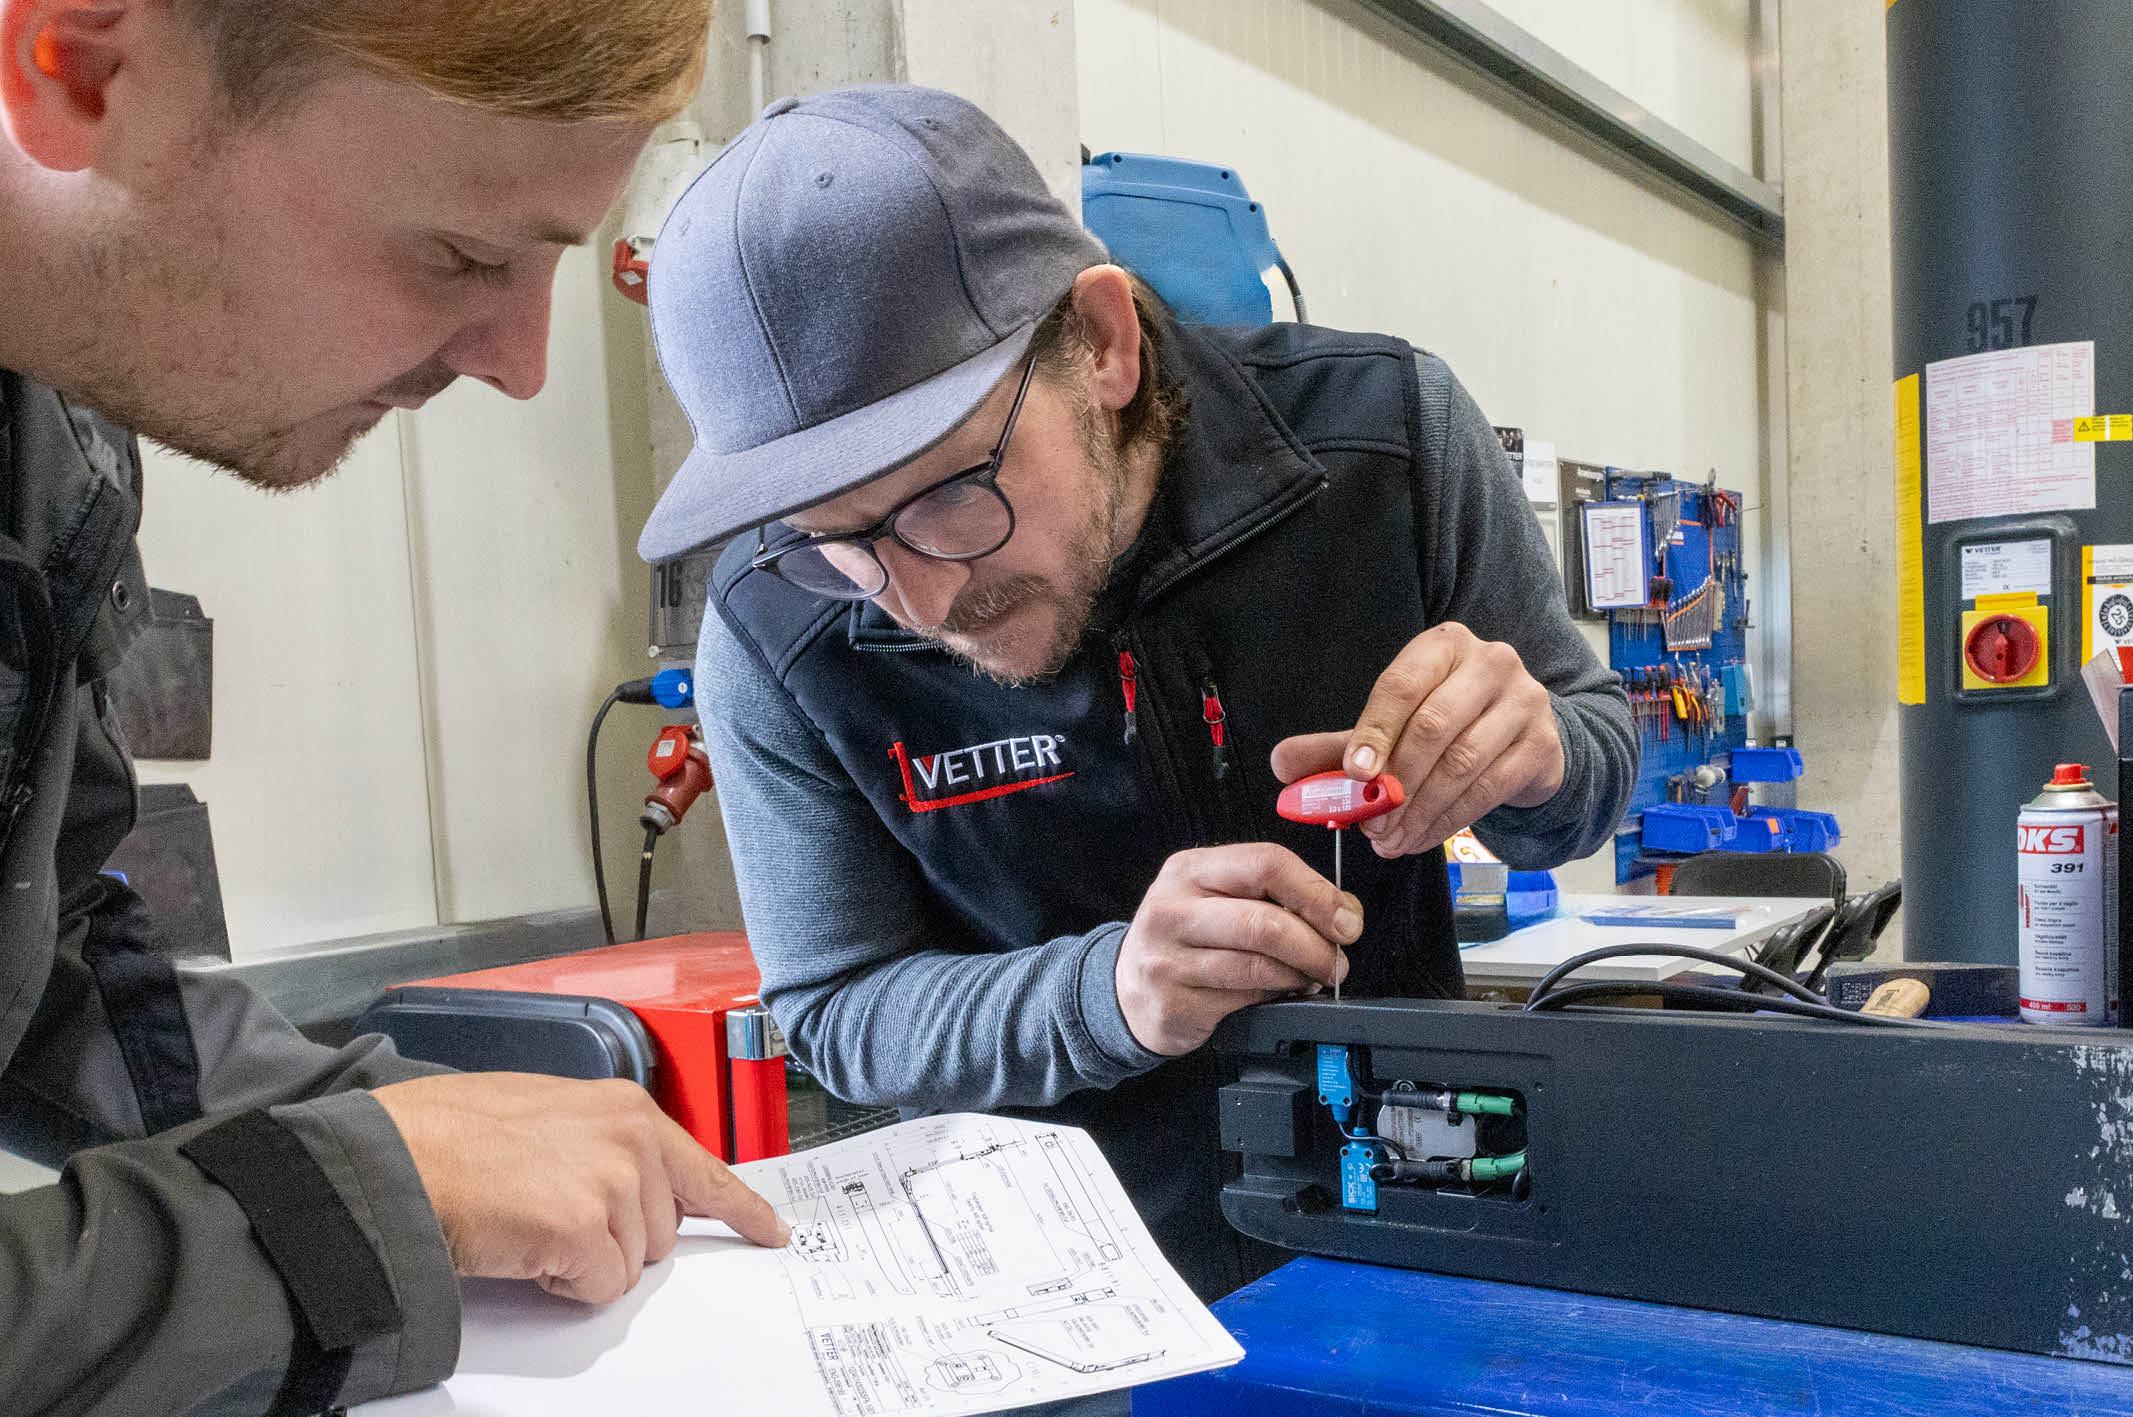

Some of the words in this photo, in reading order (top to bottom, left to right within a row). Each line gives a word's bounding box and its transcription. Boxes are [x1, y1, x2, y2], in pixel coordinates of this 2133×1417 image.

[1967, 295, 2037, 352] 957
[912, 735, 1062, 789] VETTER
[2051, 861, 2084, 873] 391
